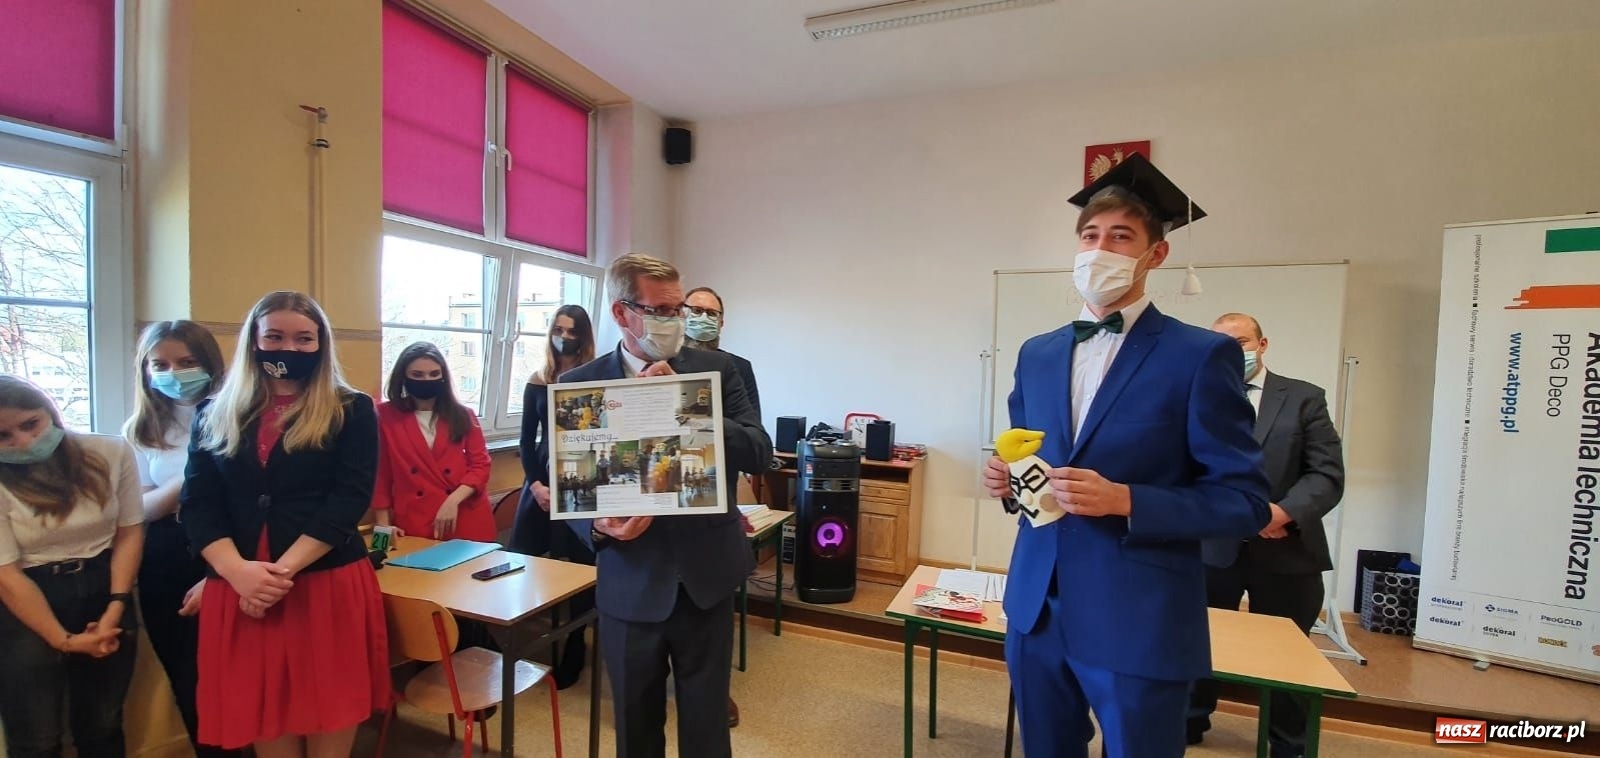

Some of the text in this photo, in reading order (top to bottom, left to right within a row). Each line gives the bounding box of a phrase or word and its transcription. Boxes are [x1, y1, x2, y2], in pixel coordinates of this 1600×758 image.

[1500, 332, 1522, 434] www.atppg.pl
[1546, 333, 1571, 418] PPG Deco
[372, 532, 389, 550] 20
[1431, 596, 1463, 607] dekoral
[1429, 616, 1461, 627] dekoral
[1482, 625, 1516, 637] dekoral
